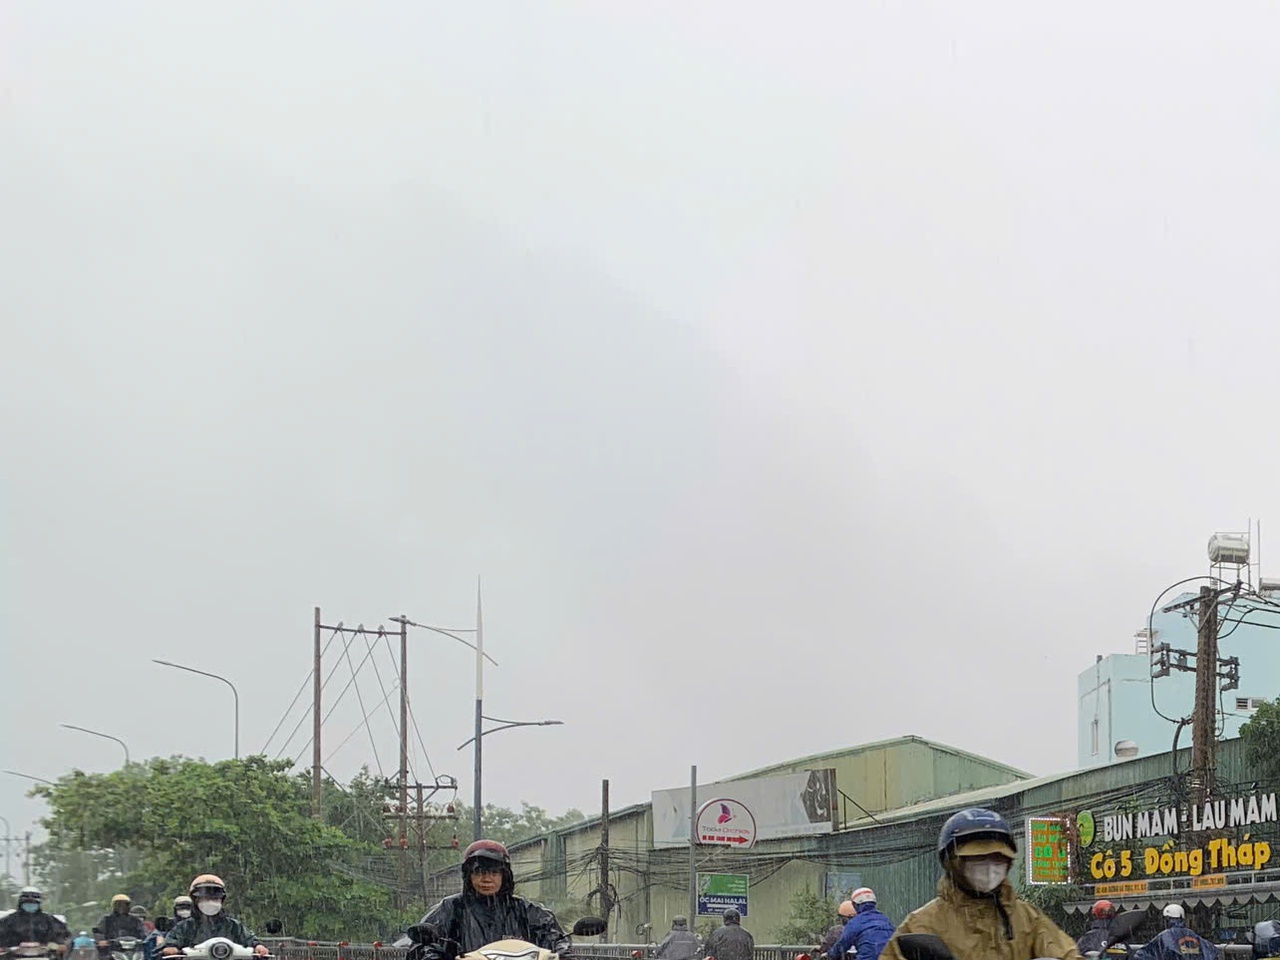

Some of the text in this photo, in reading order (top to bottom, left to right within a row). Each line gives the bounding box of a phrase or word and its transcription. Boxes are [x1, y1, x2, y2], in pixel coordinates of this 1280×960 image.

[1103, 805, 1133, 842] BÚN
[1229, 783, 1278, 828] MẮM
[1090, 833, 1272, 879] Cô 5 Đồng Tháp
